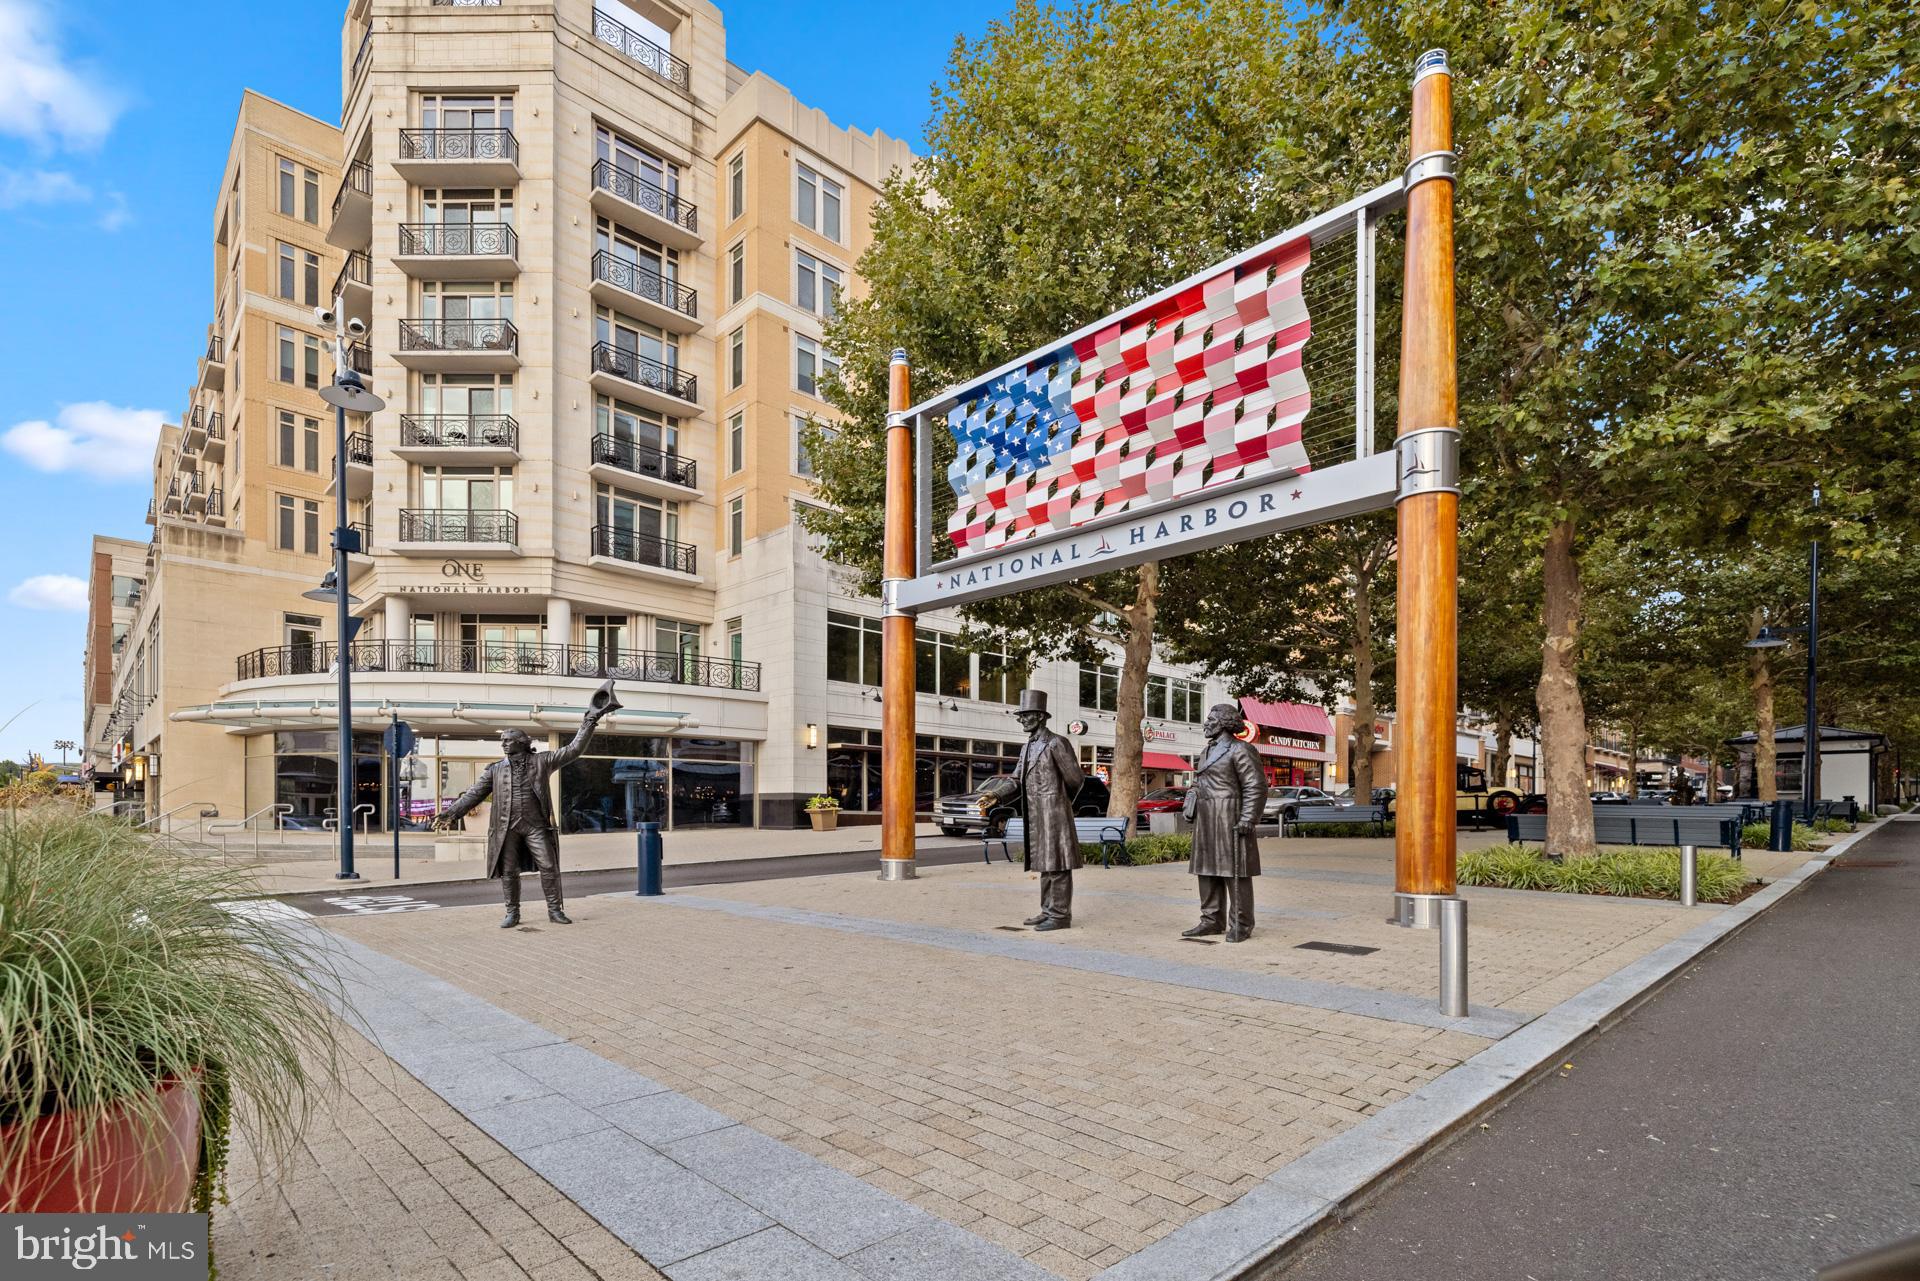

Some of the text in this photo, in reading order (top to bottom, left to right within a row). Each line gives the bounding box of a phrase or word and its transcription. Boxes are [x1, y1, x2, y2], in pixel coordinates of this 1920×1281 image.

[949, 493, 1277, 590] NATIONAL HARBOR
[441, 558, 485, 581] ONE
[1269, 735, 1320, 750] CANDY KITCHEN
